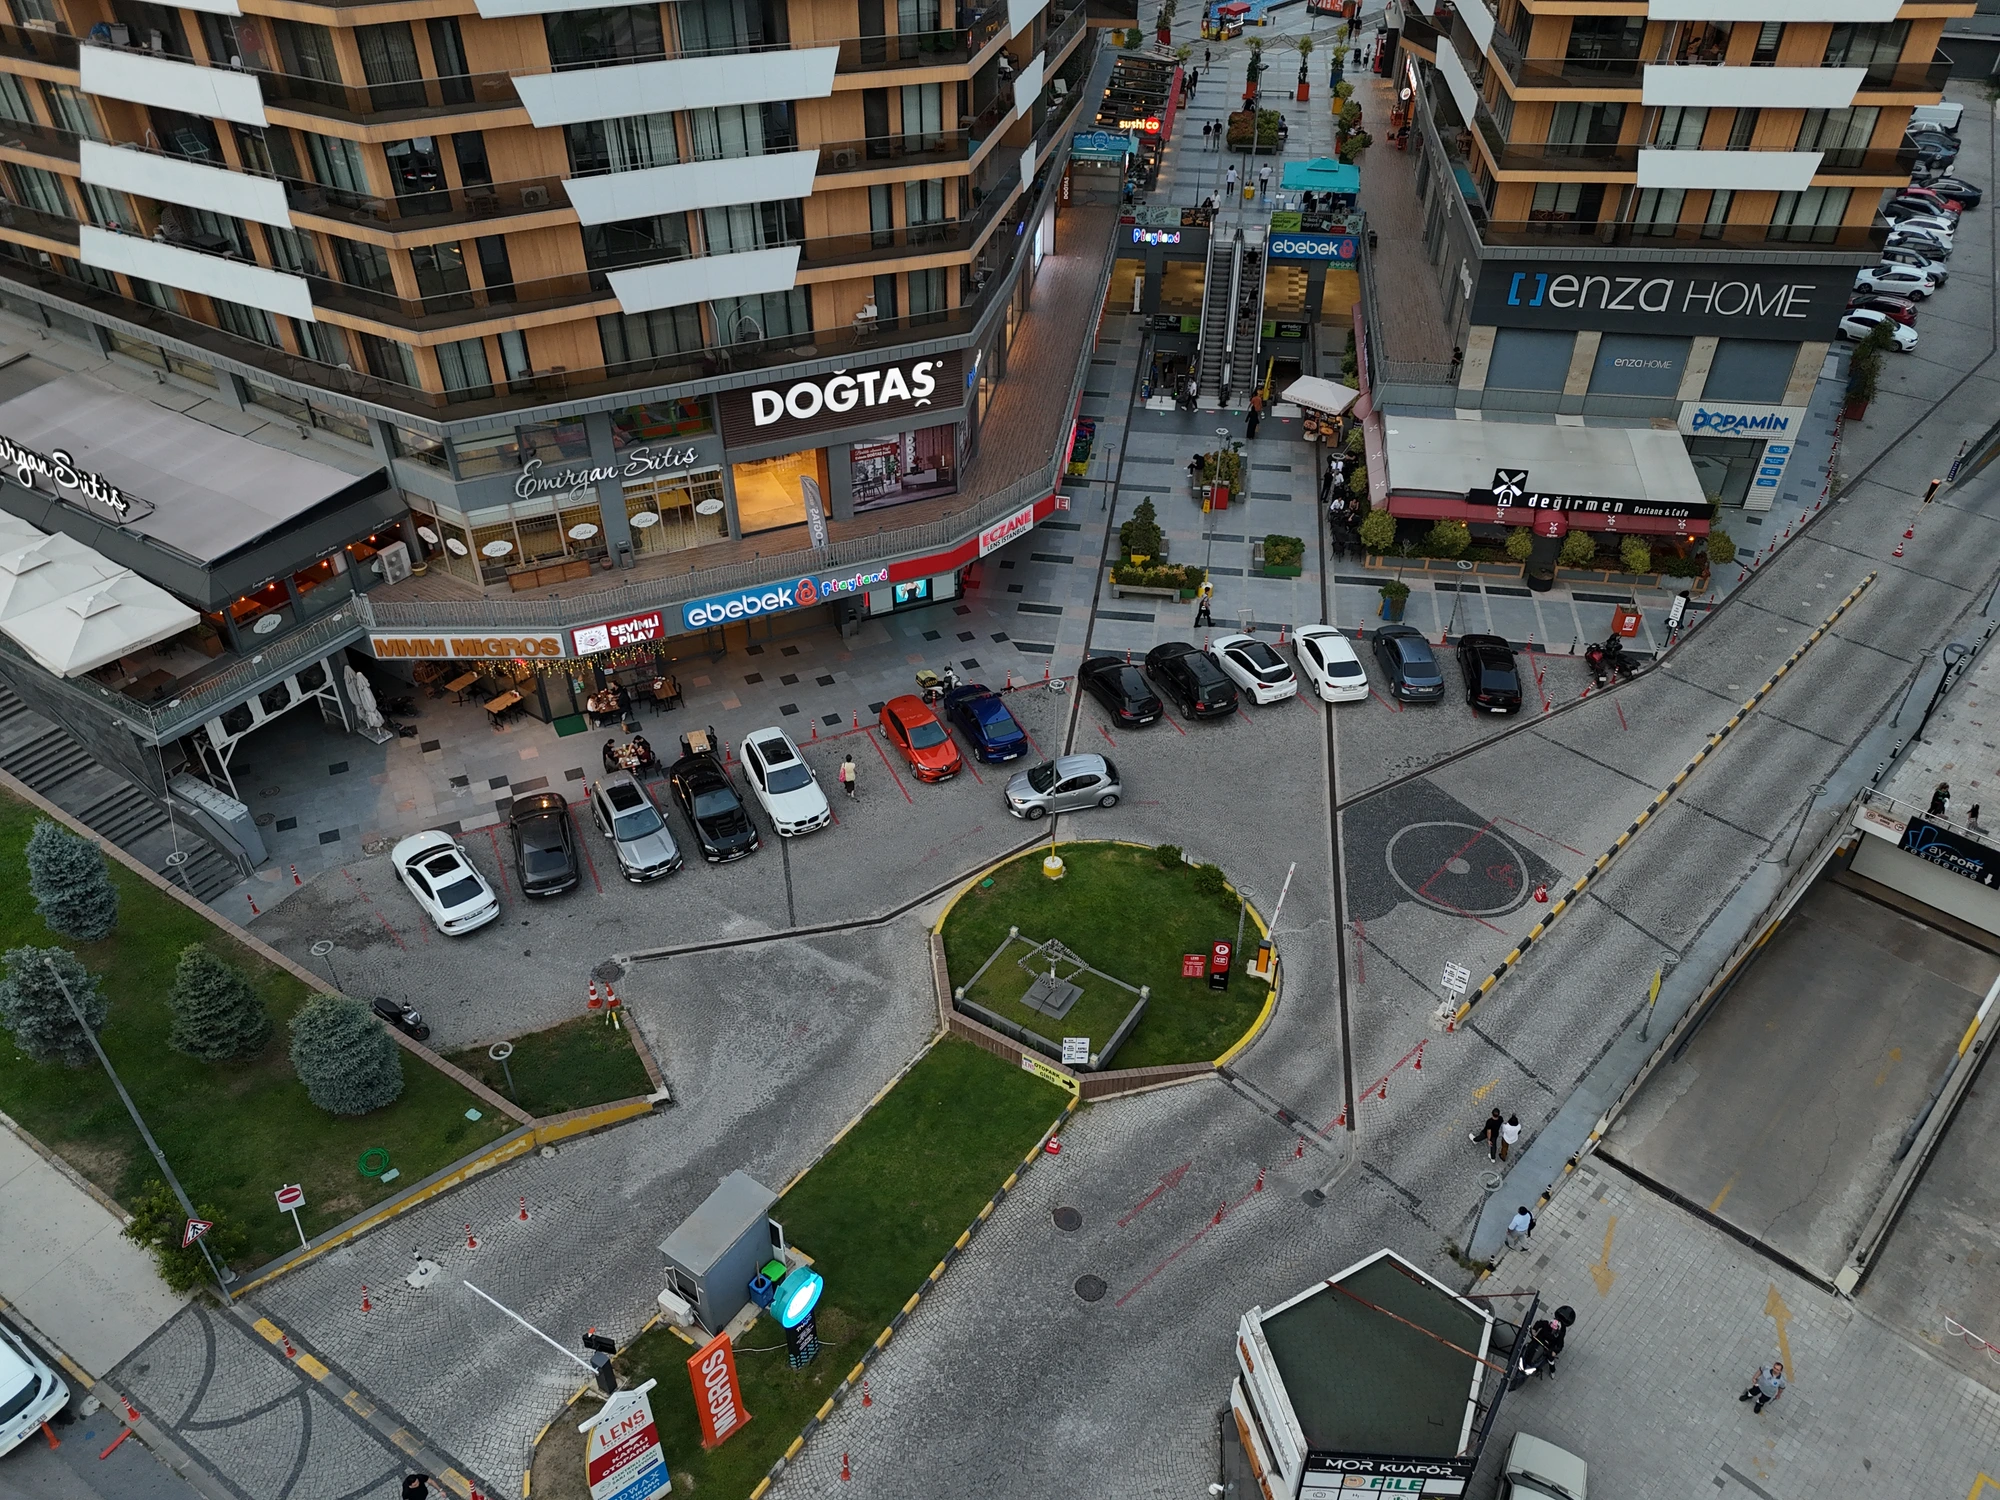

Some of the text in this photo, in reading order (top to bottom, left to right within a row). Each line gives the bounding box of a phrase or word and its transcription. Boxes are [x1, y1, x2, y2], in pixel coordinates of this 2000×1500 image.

[1272, 239, 1338, 256] ebebek
[1548, 273, 1817, 318] enza HOME
[1643, 360, 1672, 369] HOME
[752, 361, 936, 427] DOĞTAŞ
[515, 447, 699, 502] Emirgan Sütiş
[1528, 494, 1624, 513] değirmen
[1634, 505, 1663, 516] Pastane
[1671, 508, 1689, 517] Cafe
[982, 510, 1031, 547] ECZANE
[987, 540, 1001, 552] LENS
[688, 587, 793, 627] ebebek
[610, 614, 659, 636] SEVİMLİ
[619, 629, 654, 645] PİLAV
[373, 638, 448, 657] MMM
[1903, 845, 1977, 880] residence
[1034, 1062, 1061, 1079] OTOPARK
[599, 1409, 645, 1447] LENS
[602, 1442, 650, 1477] OTOPARK
[611, 1436, 648, 1464] KAPALI
[1325, 1458, 1453, 1476] MOR KUAFÖR
